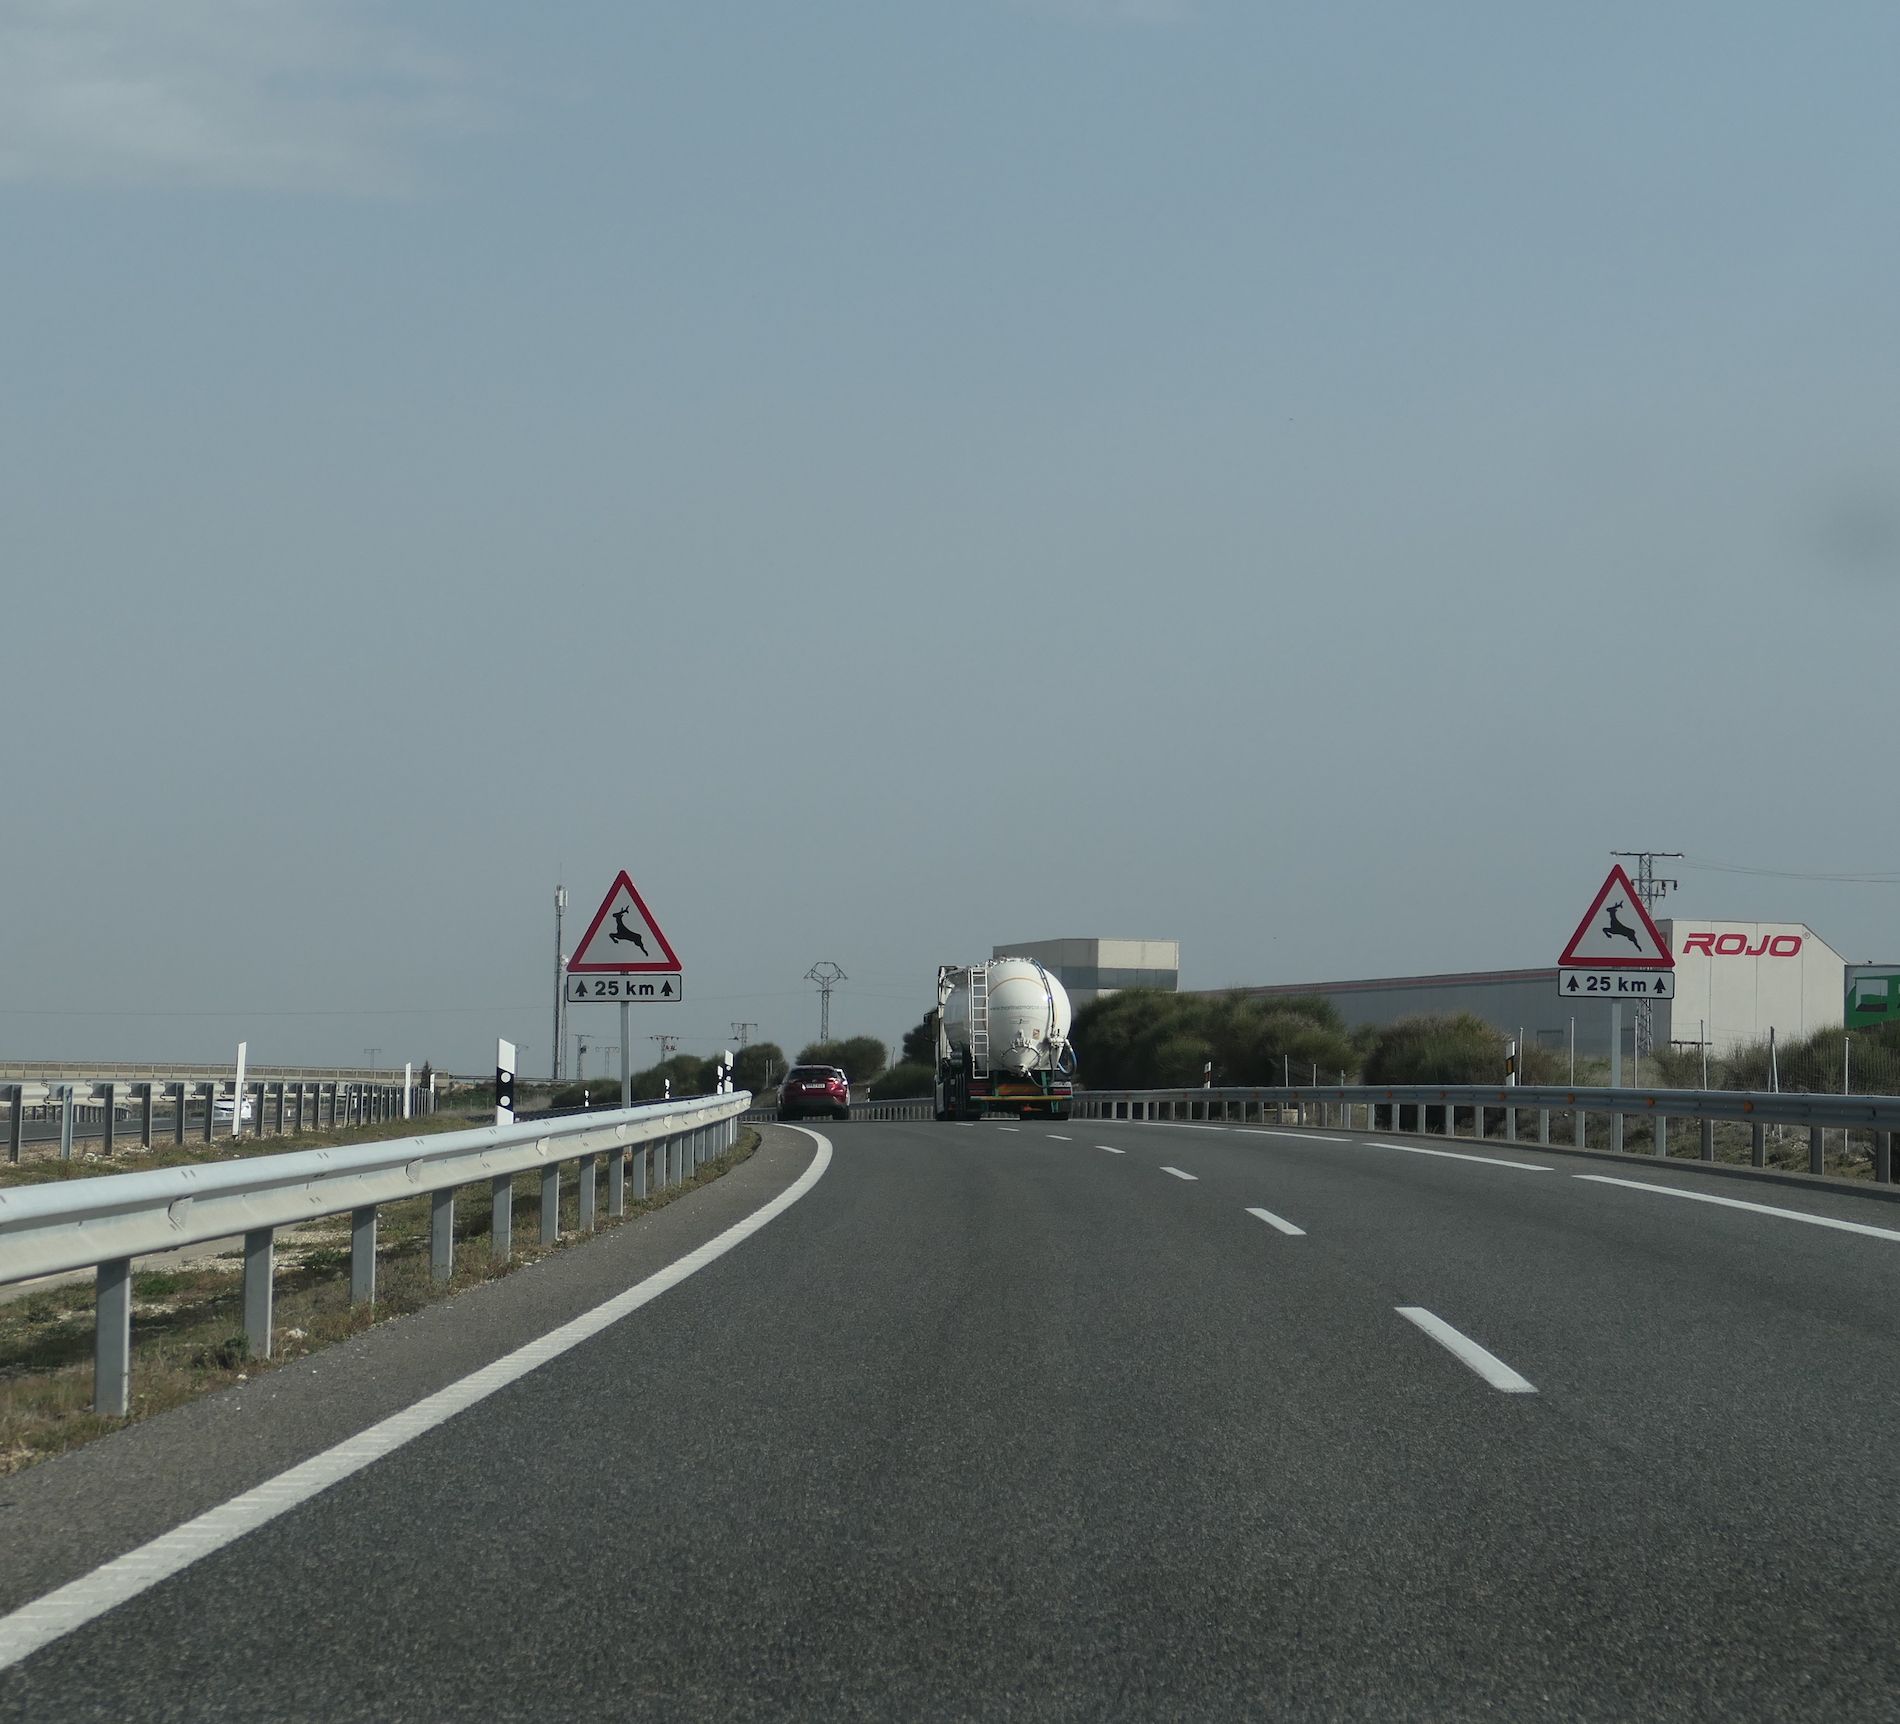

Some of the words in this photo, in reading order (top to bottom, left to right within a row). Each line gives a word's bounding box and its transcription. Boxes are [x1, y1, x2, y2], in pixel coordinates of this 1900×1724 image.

[1682, 933, 1803, 957] ROJO
[595, 981, 618, 996] 25
[626, 981, 654, 996] km
[1586, 975, 1611, 992] 25
[1618, 976, 1647, 992] km
